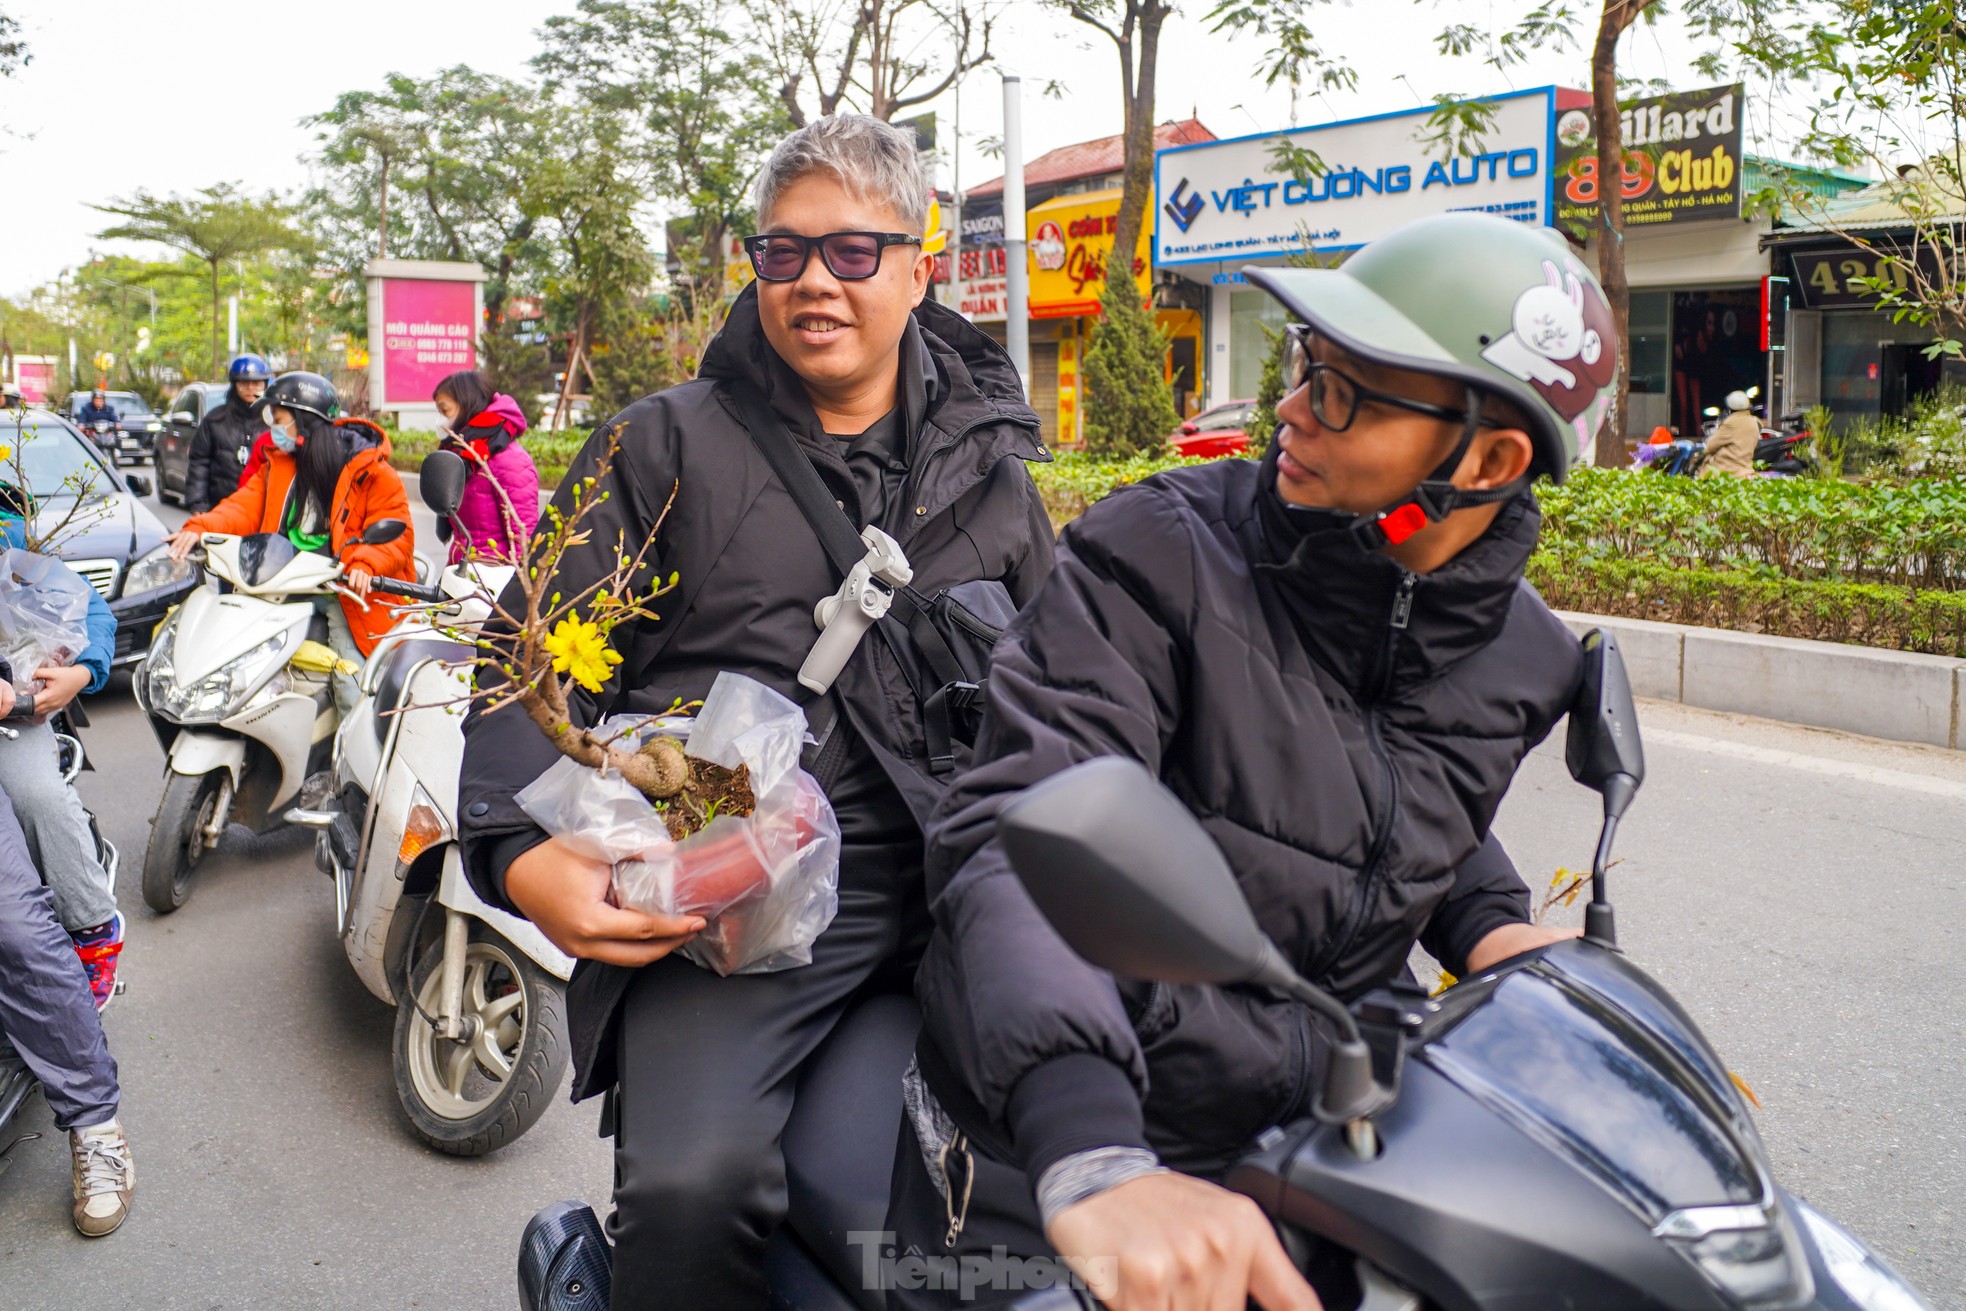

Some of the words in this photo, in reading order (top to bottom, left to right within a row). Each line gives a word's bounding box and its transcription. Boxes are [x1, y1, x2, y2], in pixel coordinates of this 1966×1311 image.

[1594, 93, 1734, 149] illard
[1211, 178, 1278, 218] VIỆT
[1283, 164, 1411, 206] CƯỜNG
[1421, 147, 1539, 190] AUTO
[1658, 144, 1734, 195] Club
[1632, 200, 1657, 212] QUÂN
[1663, 197, 1679, 209] TÂY
[1681, 194, 1695, 208] HỒ
[1702, 194, 1715, 206] HÀ
[1717, 193, 1733, 206] NỘI
[1809, 258, 1908, 295] 420
